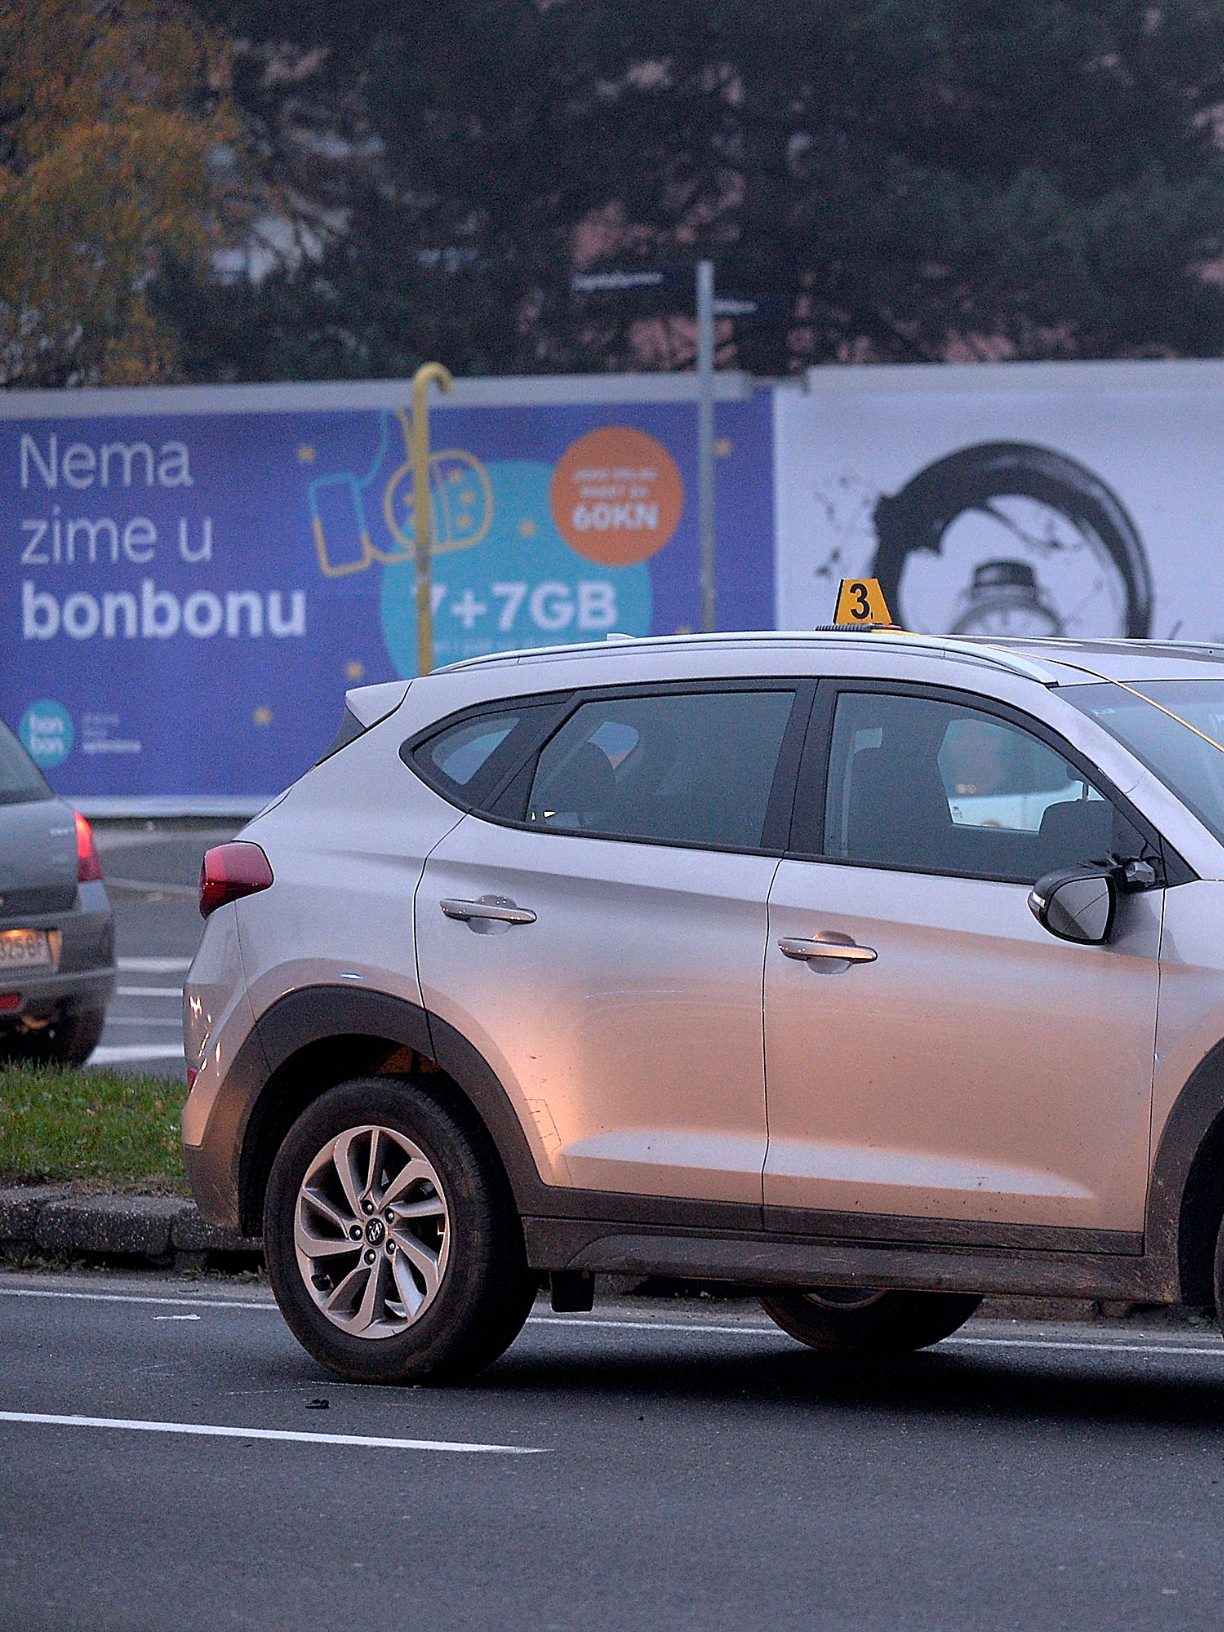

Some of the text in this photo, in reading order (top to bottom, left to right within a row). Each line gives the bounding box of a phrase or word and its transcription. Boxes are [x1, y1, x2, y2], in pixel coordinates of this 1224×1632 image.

[20, 433, 194, 489] Nema
[20, 503, 212, 564] zime u
[571, 503, 659, 532] 60KN
[22, 578, 306, 640] bonbonu
[849, 582, 871, 620] 3
